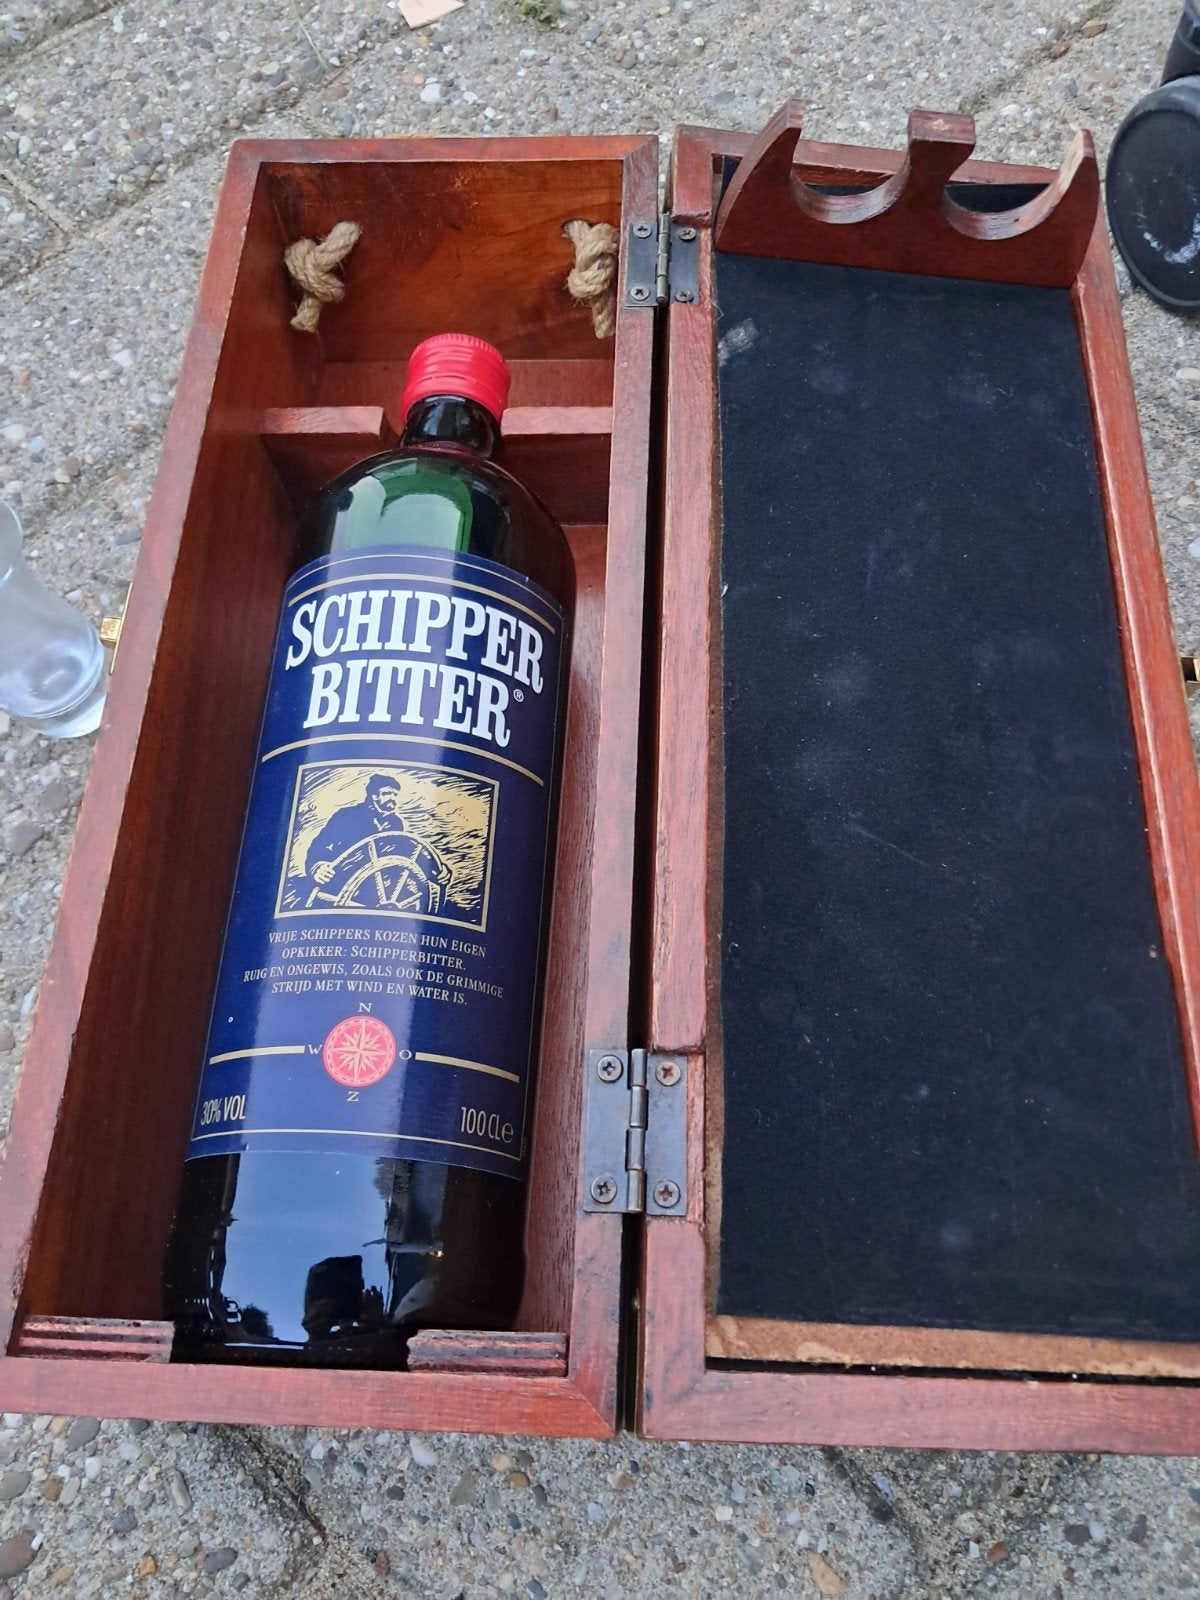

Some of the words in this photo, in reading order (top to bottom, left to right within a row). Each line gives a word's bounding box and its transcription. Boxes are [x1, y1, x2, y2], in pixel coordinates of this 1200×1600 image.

[285, 589, 544, 694] SCHIPPER
[303, 659, 511, 747] BITTER
[268, 930, 298, 944] VRIJE
[300, 928, 372, 941] SCHIPPERS
[374, 930, 418, 944] KOZEN
[421, 934, 449, 949] HUN
[451, 940, 487, 958] EIGEN
[282, 946, 347, 959] OPKIKKER:
[350, 945, 466, 971] SCHIPPERBITTER.
[243, 968, 268, 983] RUIG
[269, 967, 285, 978] EN
[287, 963, 348, 977] ONGEWIS,
[351, 963, 392, 977] ZOALS
[396, 967, 423, 981] OOK
[426, 970, 444, 983] DE
[446, 974, 504, 999] GRIMMIGE
[271, 981, 311, 994] STRIJD
[315, 980, 344, 991] MET
[346, 980, 383, 993] WIND
[386, 982, 404, 995] EN
[408, 984, 449, 1002] WATER
[452, 991, 468, 1006] IS.
[358, 1002, 373, 1013] N
[308, 1044, 323, 1055] W
[200, 1098, 223, 1126] 30%
[223, 1094, 247, 1122] VOL
[347, 1090, 360, 1103] Z
